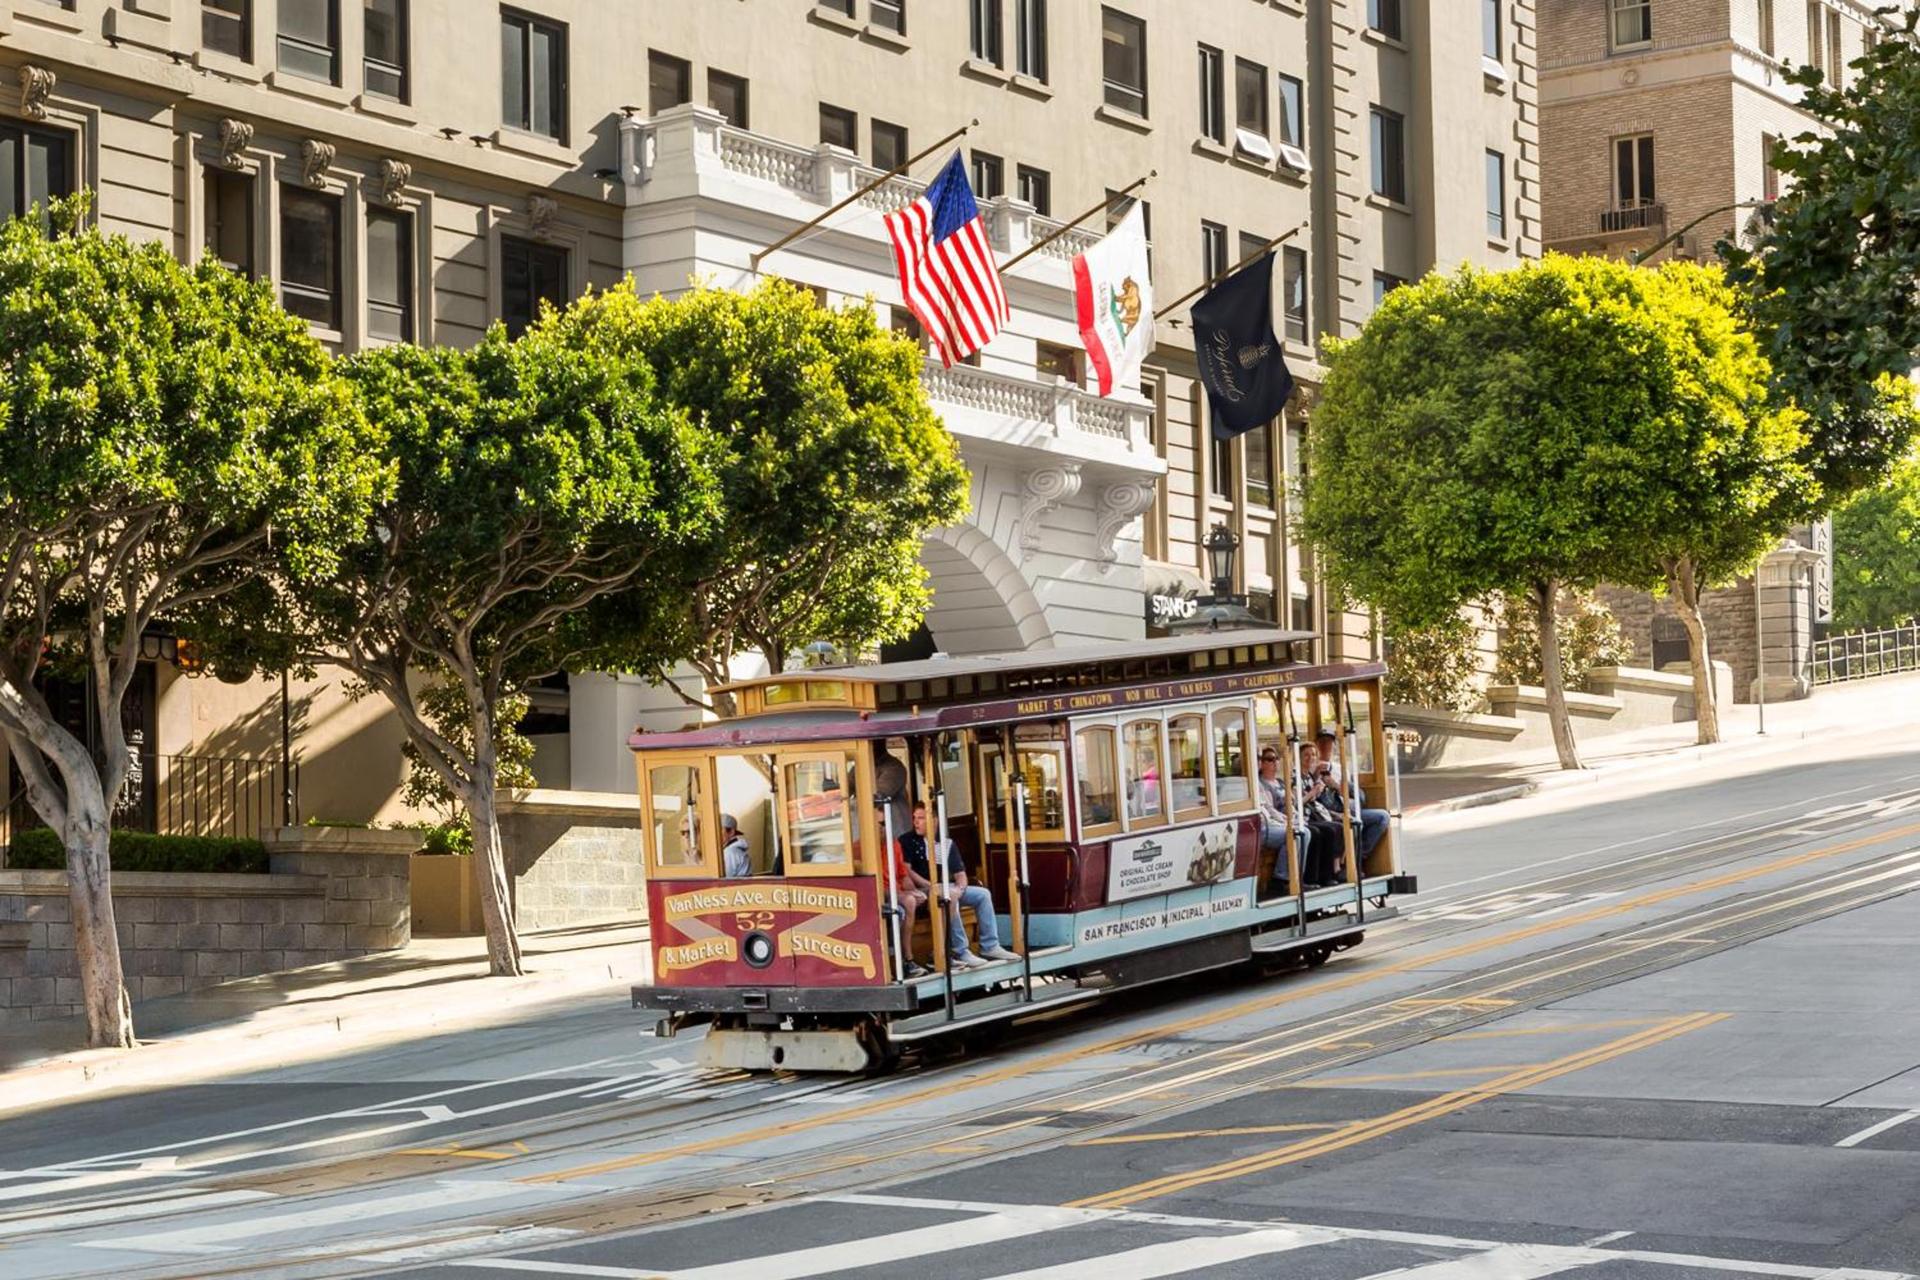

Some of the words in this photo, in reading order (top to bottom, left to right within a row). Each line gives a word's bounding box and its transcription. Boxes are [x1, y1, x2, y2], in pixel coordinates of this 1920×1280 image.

[1818, 526, 1830, 607] ARKING
[1018, 700, 1048, 714] MARKET
[1070, 693, 1113, 709] CHINATOWN
[1144, 687, 1161, 700] HILL
[1243, 675, 1285, 688] CALIFORNIA
[972, 708, 985, 719] 52
[1119, 867, 1145, 878] ORIGINAL
[1154, 861, 1174, 871] CREAM
[1125, 874, 1156, 887] CHOCOLATE
[772, 888, 855, 910] California
[735, 911, 776, 931] 52
[1084, 926, 1104, 941] SAN
[1106, 915, 1157, 936] FRANCISCO
[1212, 897, 1244, 913] RAILWAY
[665, 947, 676, 964] &
[678, 940, 731, 963] Market
[792, 935, 862, 960] Streets
